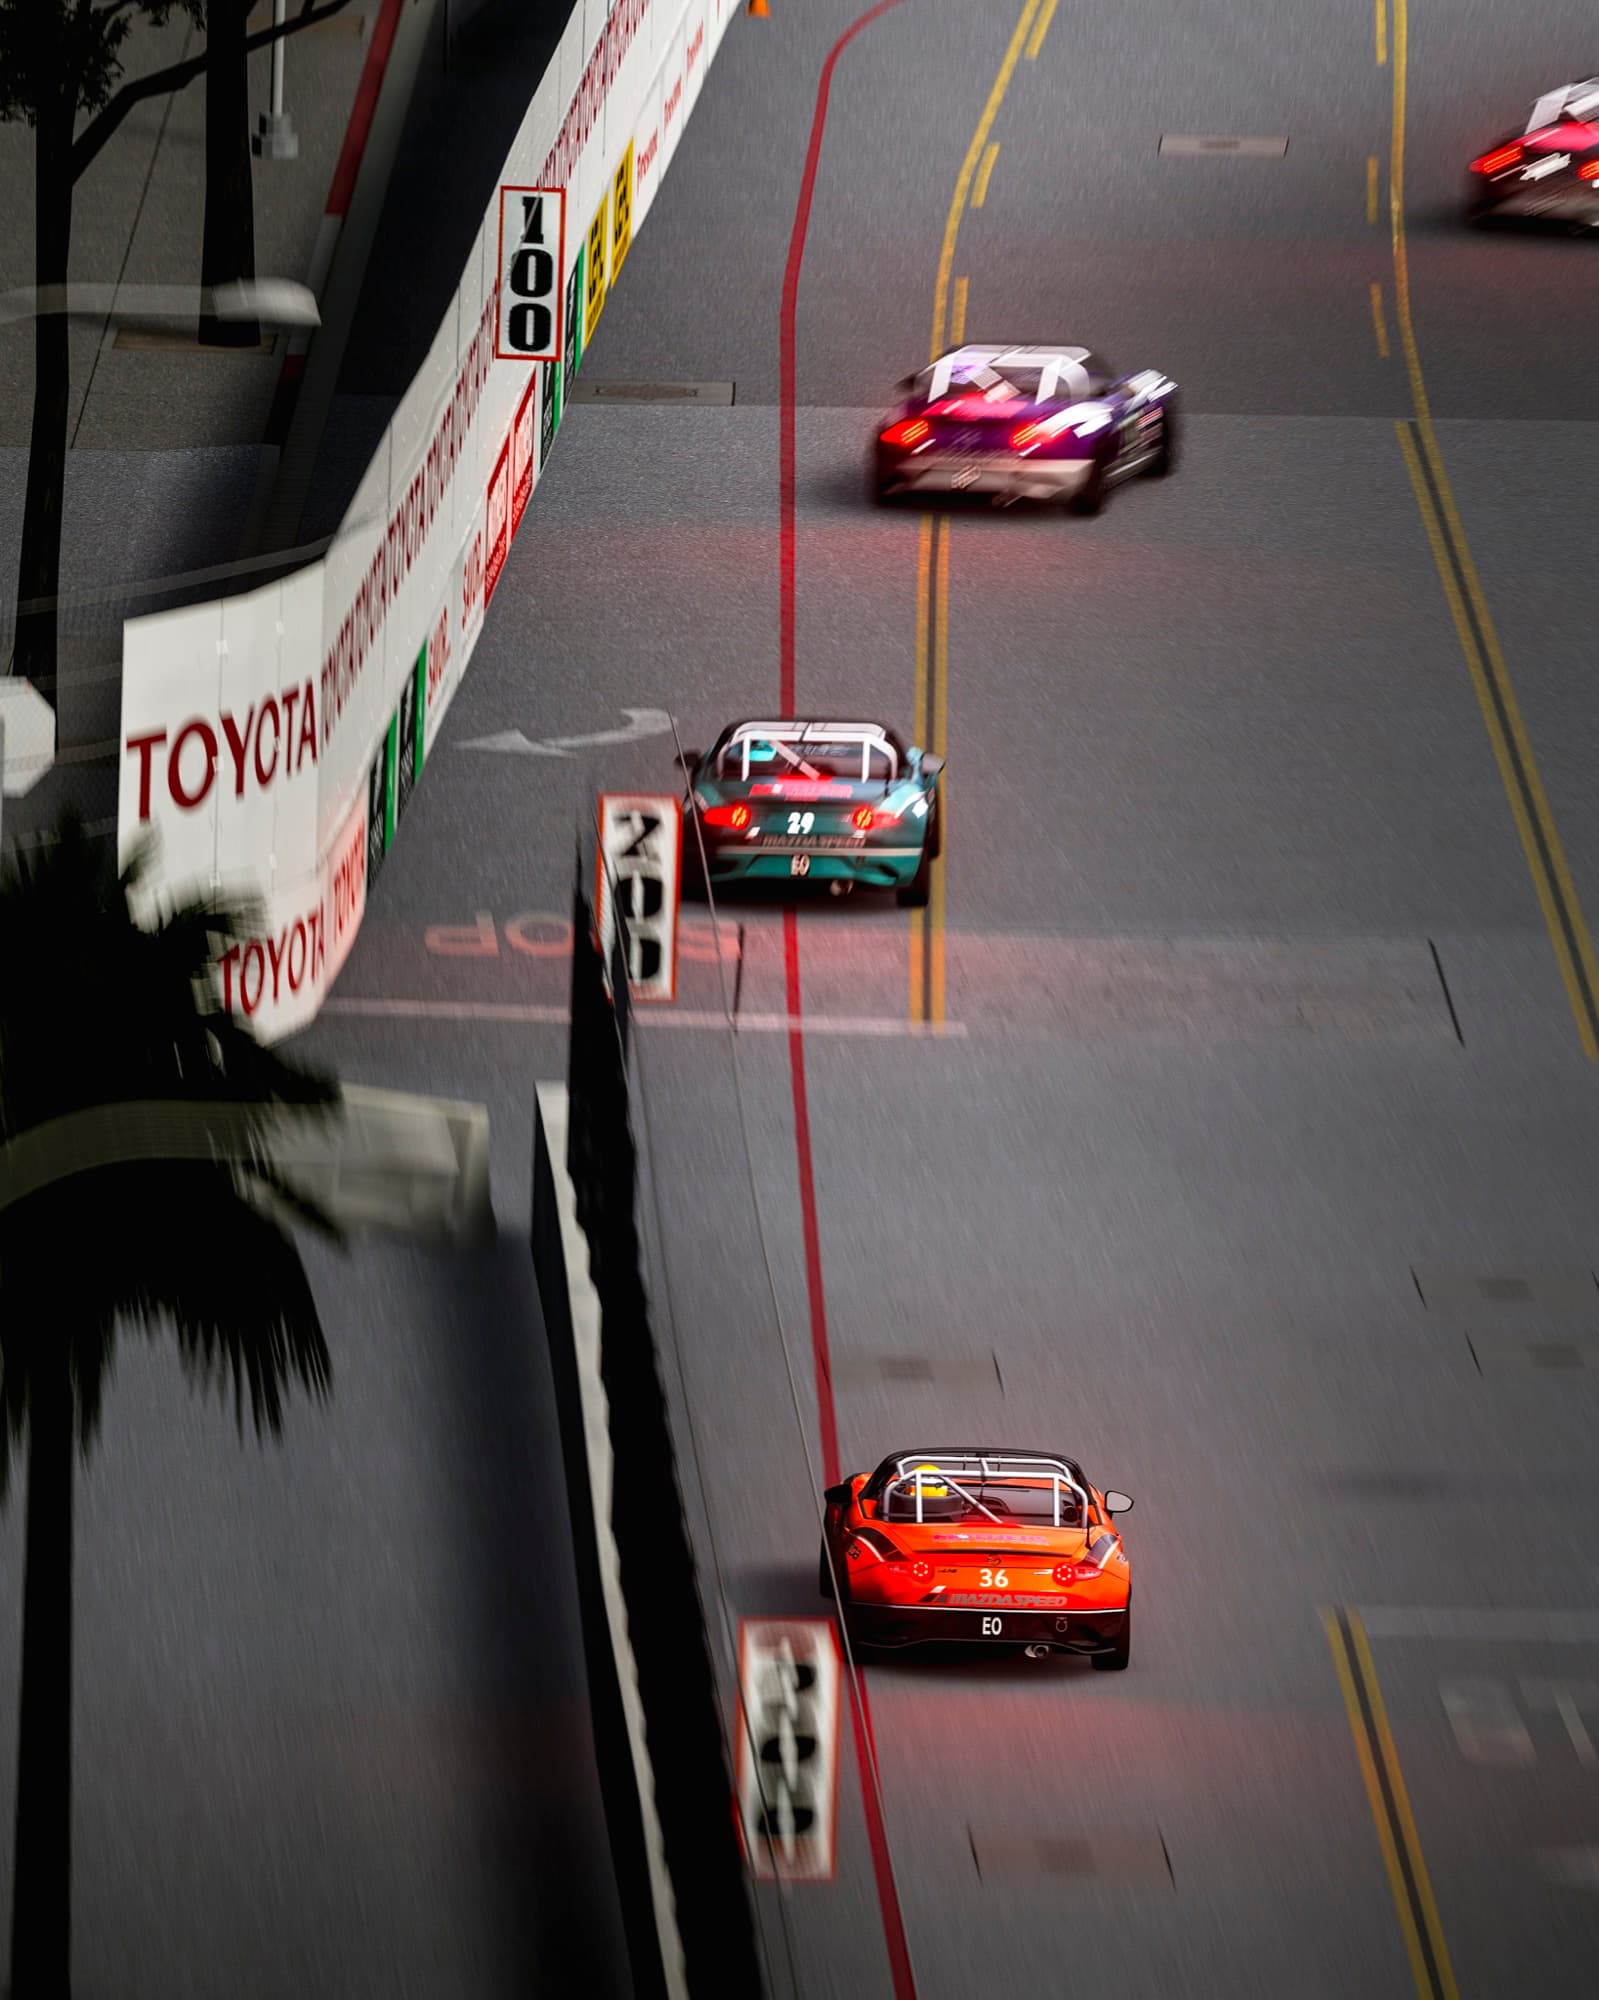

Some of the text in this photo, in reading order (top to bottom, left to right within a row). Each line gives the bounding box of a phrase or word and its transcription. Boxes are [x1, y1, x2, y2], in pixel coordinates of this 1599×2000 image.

[508, 196, 554, 353] 100
[126, 678, 318, 823] TOYOTA
[786, 812, 816, 834] 29
[217, 897, 325, 1016] TOYOTA
[949, 1592, 1067, 1608] MAZDASPEED
[978, 1568, 1009, 1588] 36
